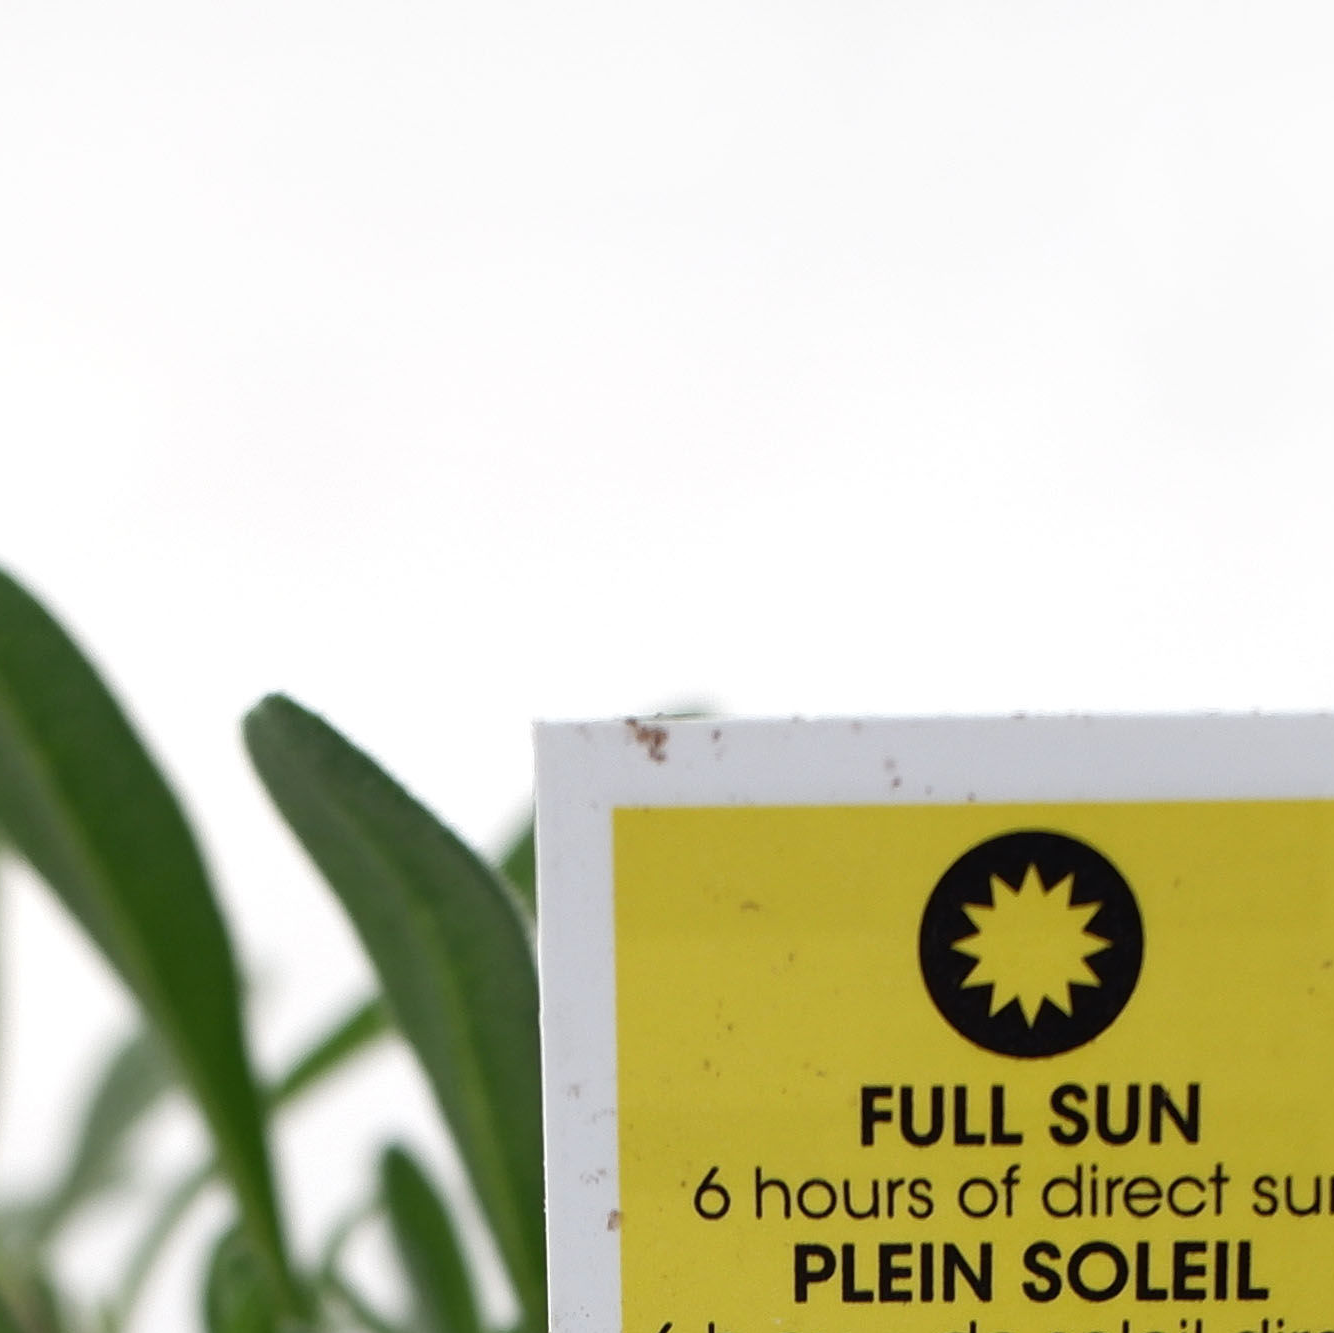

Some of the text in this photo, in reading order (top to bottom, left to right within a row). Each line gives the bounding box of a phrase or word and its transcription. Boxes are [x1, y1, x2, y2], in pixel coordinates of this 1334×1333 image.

[861, 1081, 1201, 1148] FULL SUN
[693, 1166, 732, 1222] 6
[754, 1169, 933, 1220] hours
[957, 1166, 1020, 1219] of
[1040, 1164, 1229, 1219] direct
[794, 1241, 1269, 1303] PLEIN SOLEIL
